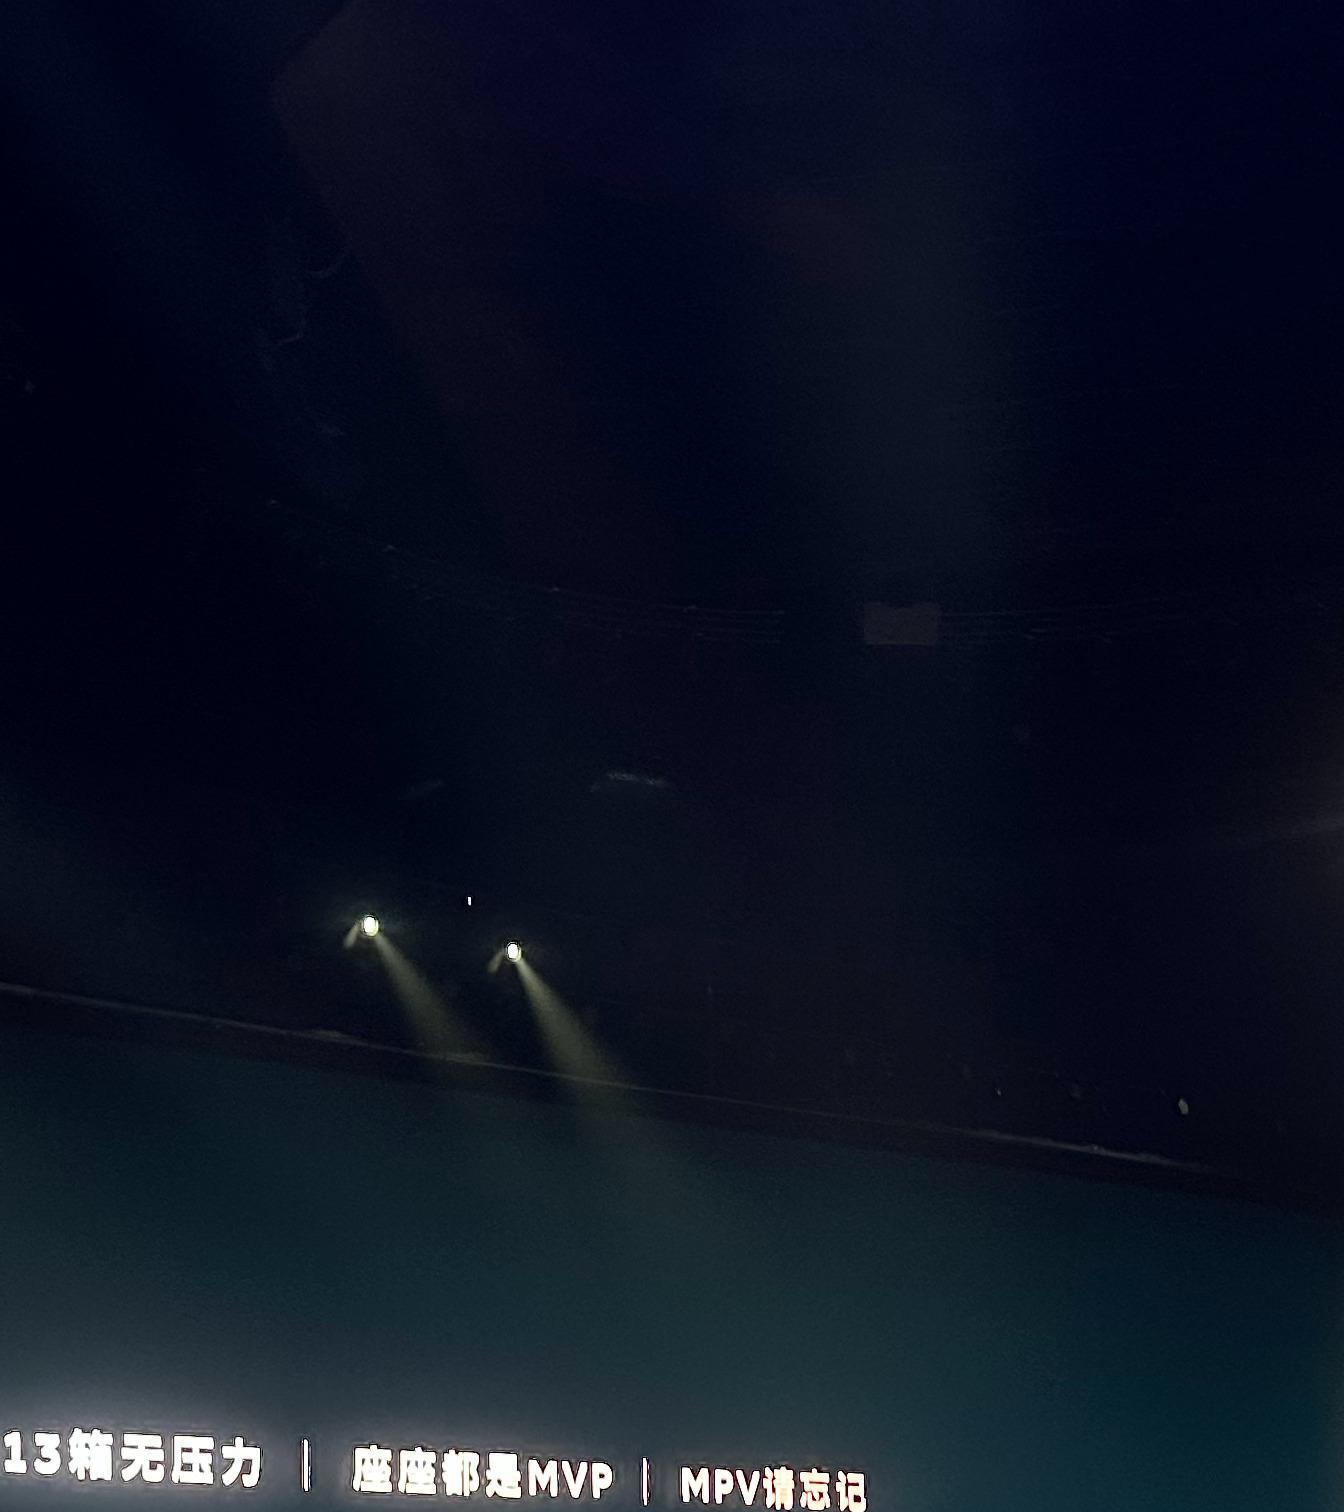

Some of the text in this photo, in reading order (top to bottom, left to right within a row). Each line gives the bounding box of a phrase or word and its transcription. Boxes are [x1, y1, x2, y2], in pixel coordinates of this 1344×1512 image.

[351, 1444, 614, 1501] 座座都是MVP
[680, 1466, 868, 1512] MPV请忘记
